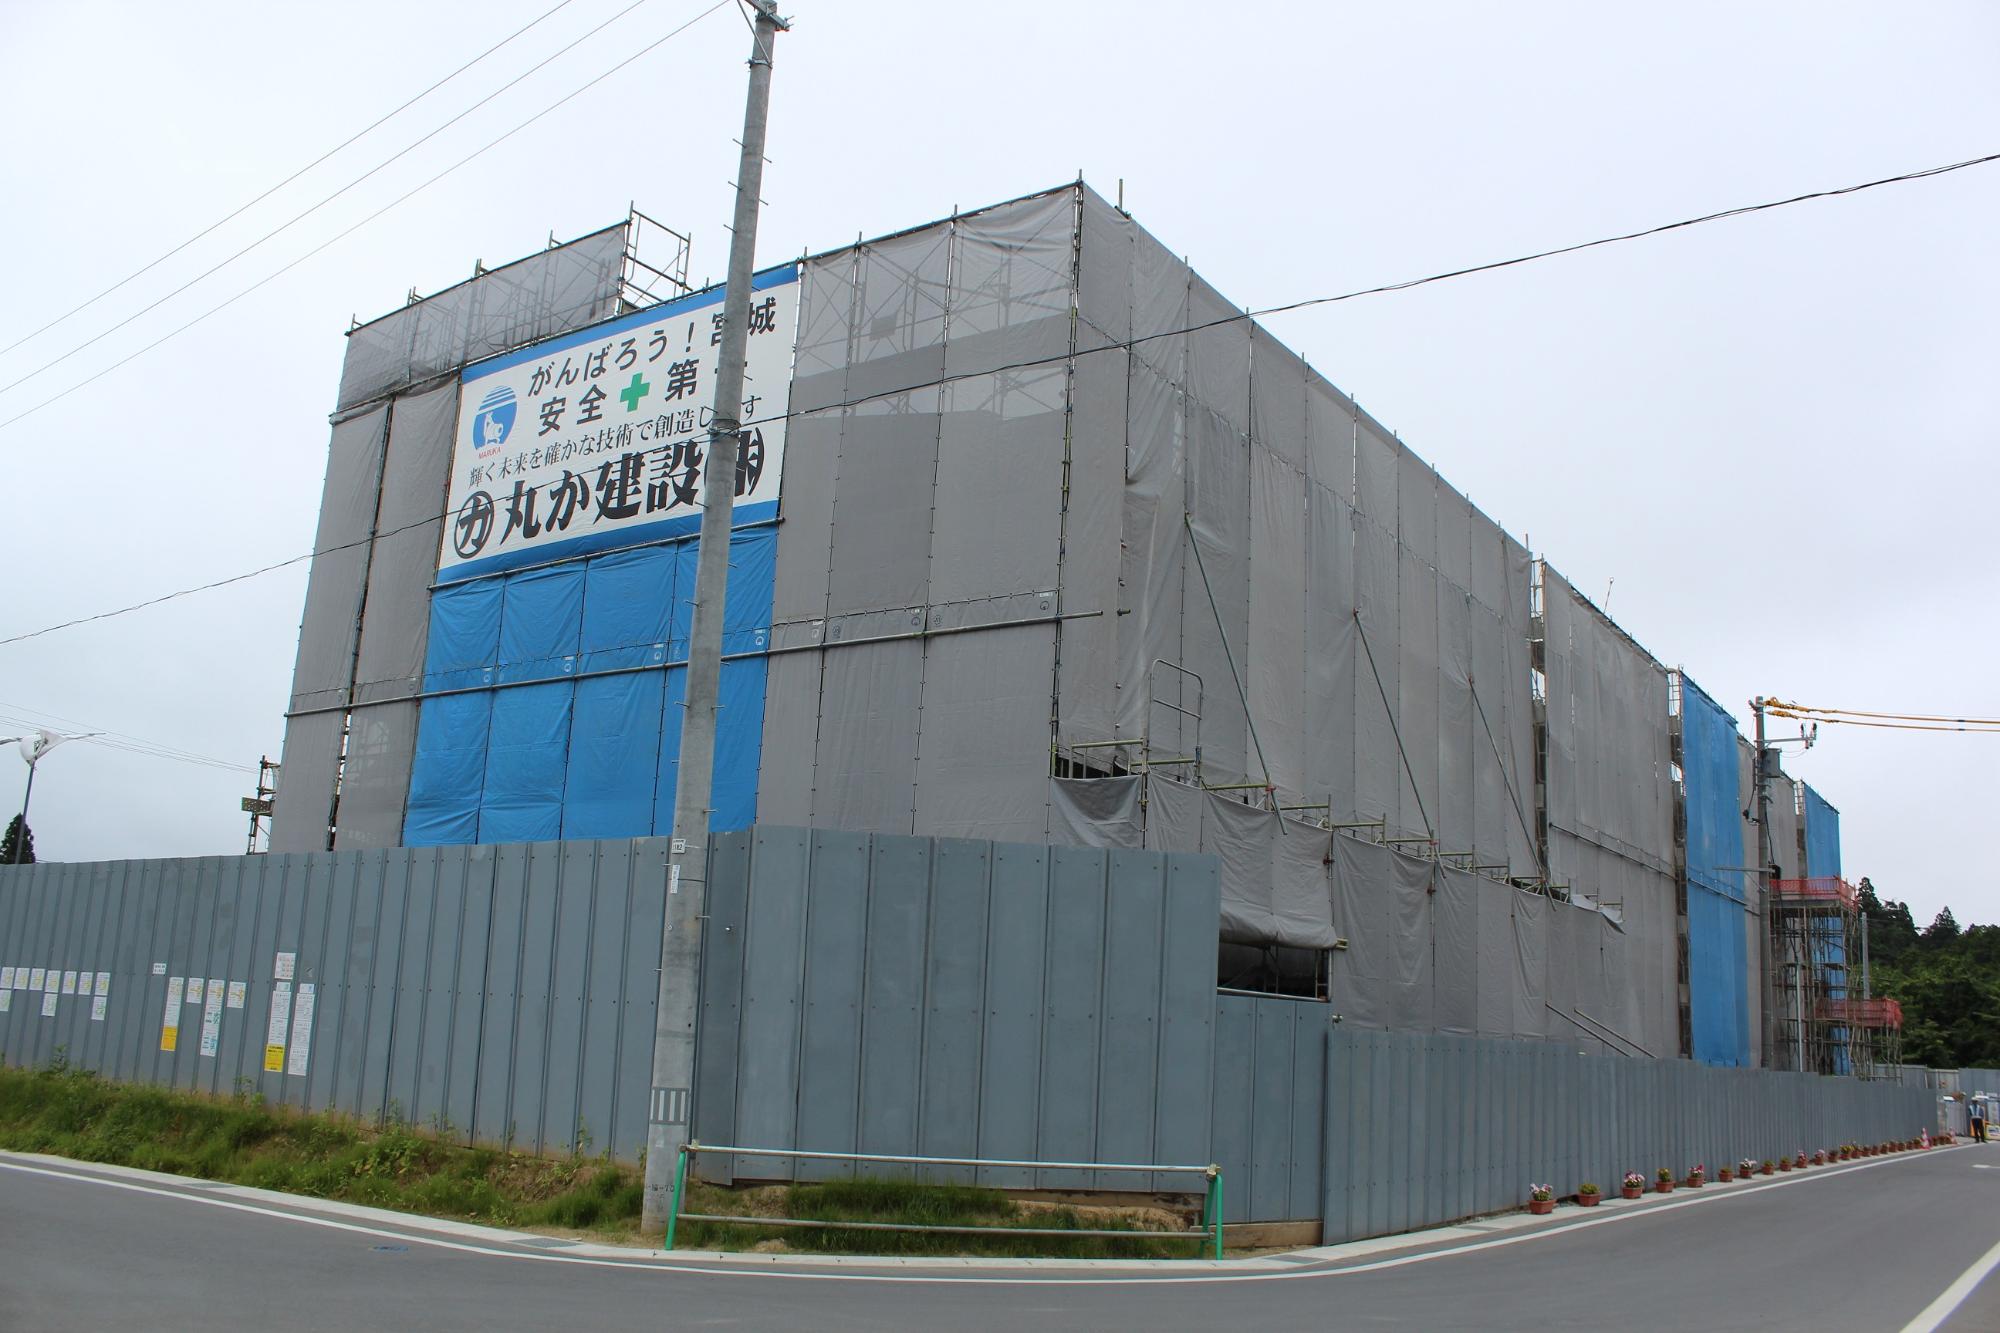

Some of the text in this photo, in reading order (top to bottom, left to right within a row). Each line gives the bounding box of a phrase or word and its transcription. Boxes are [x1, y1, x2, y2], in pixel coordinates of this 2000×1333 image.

[469, 395, 762, 489] 輝く未来を確かな技術で創造しす
